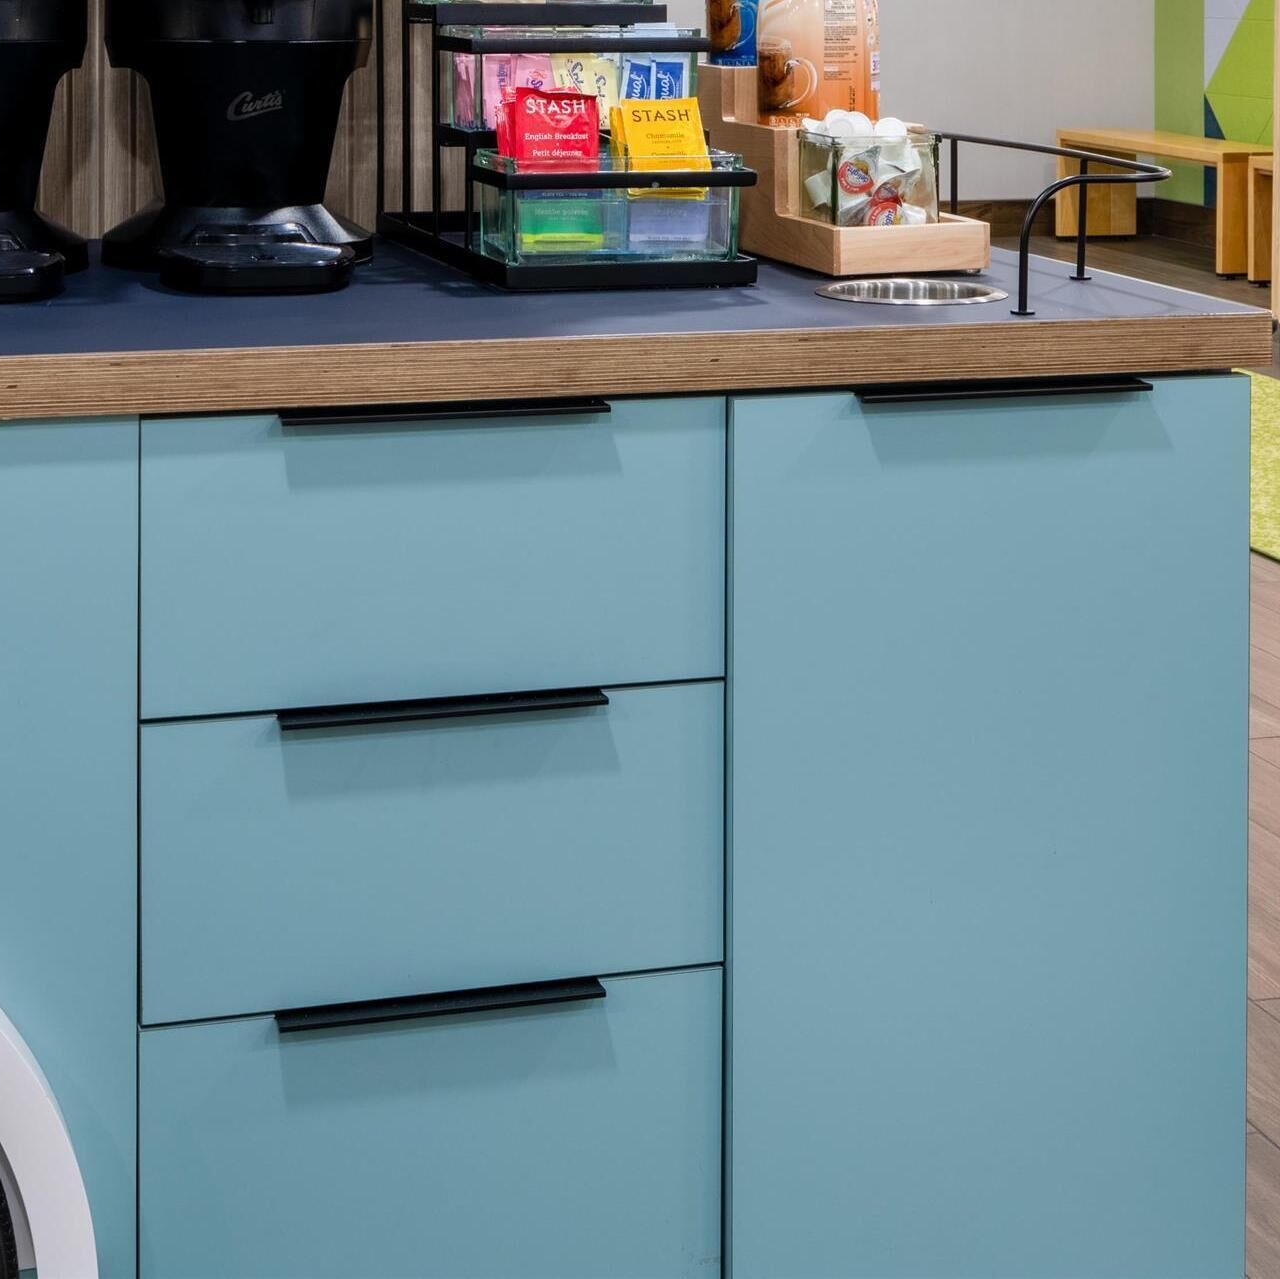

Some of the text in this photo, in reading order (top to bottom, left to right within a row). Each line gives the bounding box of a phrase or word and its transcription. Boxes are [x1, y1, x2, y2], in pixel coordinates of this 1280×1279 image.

[227, 91, 283, 120] Curtis
[526, 99, 586, 114] STASH
[632, 109, 690, 122] STASH
[524, 132, 588, 141] English Breakfast
